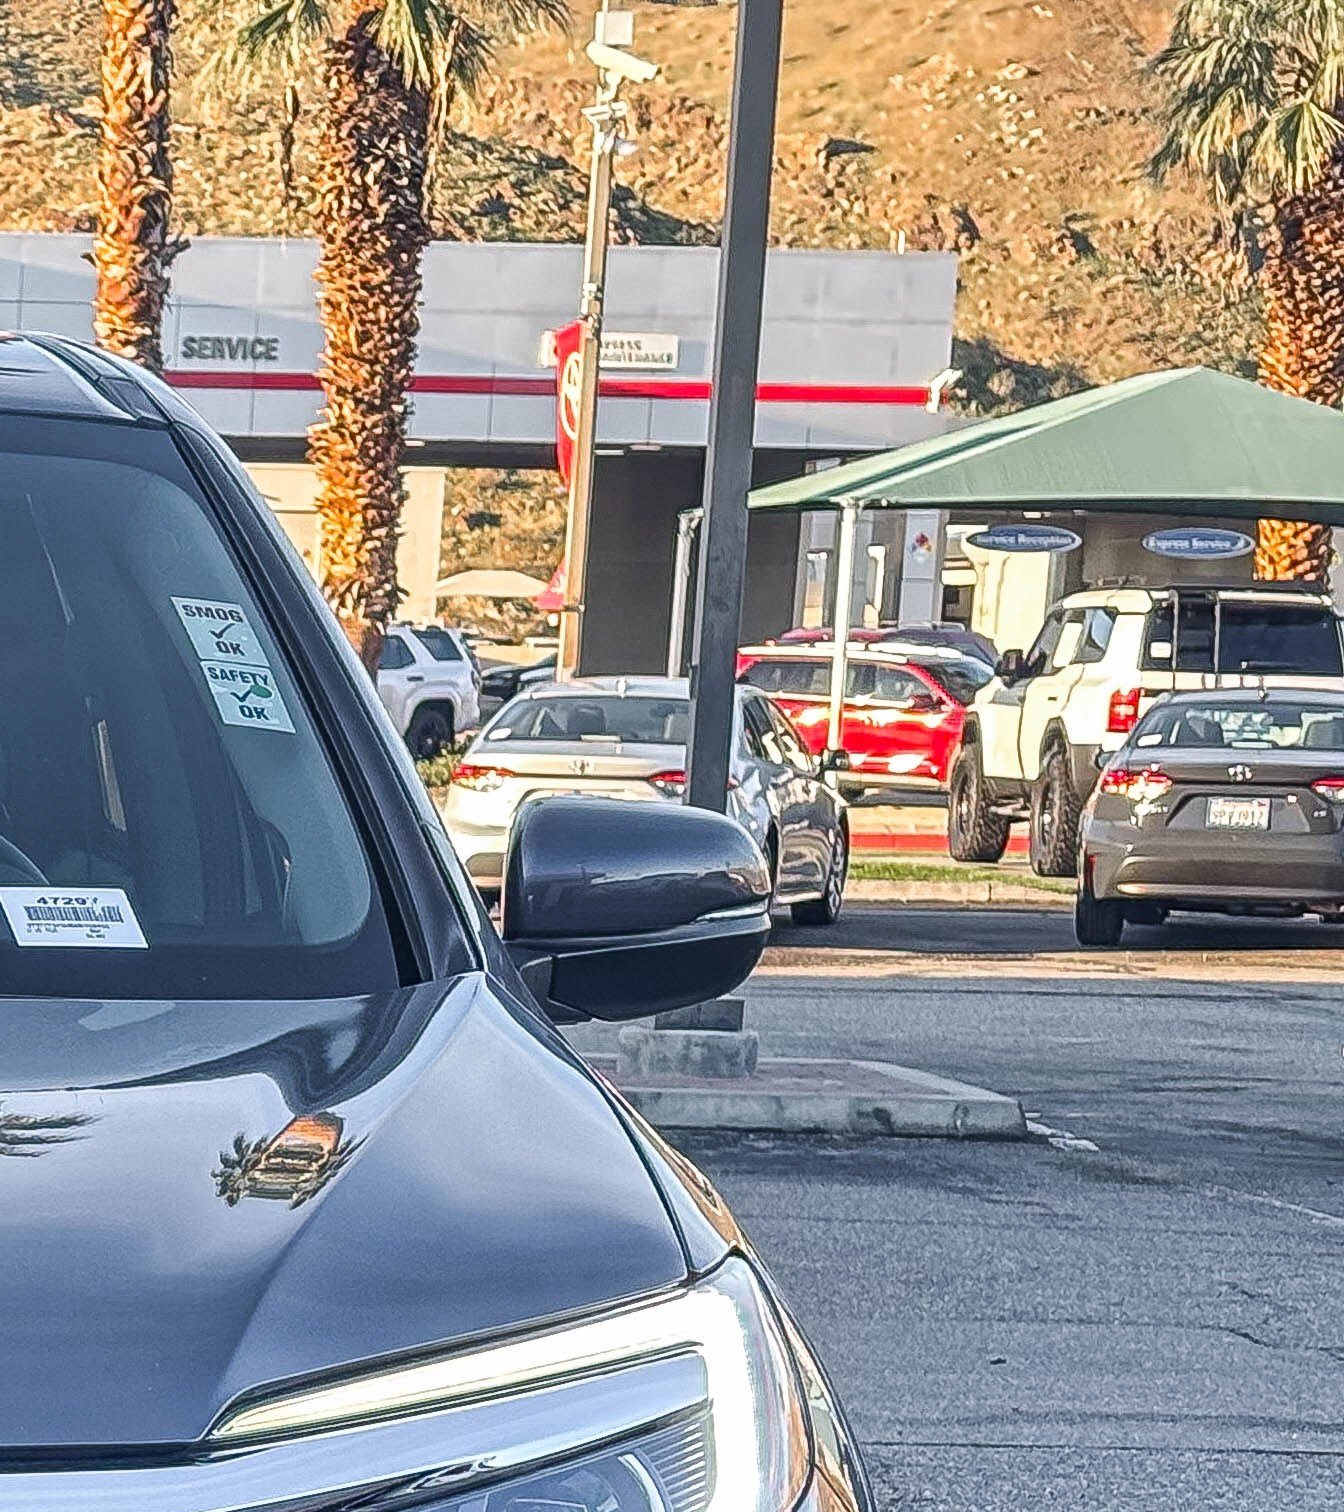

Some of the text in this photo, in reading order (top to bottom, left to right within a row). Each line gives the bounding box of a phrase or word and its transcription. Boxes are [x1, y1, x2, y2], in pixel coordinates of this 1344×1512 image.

[182, 336, 280, 360] SERVICE
[181, 604, 244, 623] SMOG
[215, 640, 245, 657] OK
[207, 667, 270, 686] SAFETY
[238, 705, 270, 721] OK
